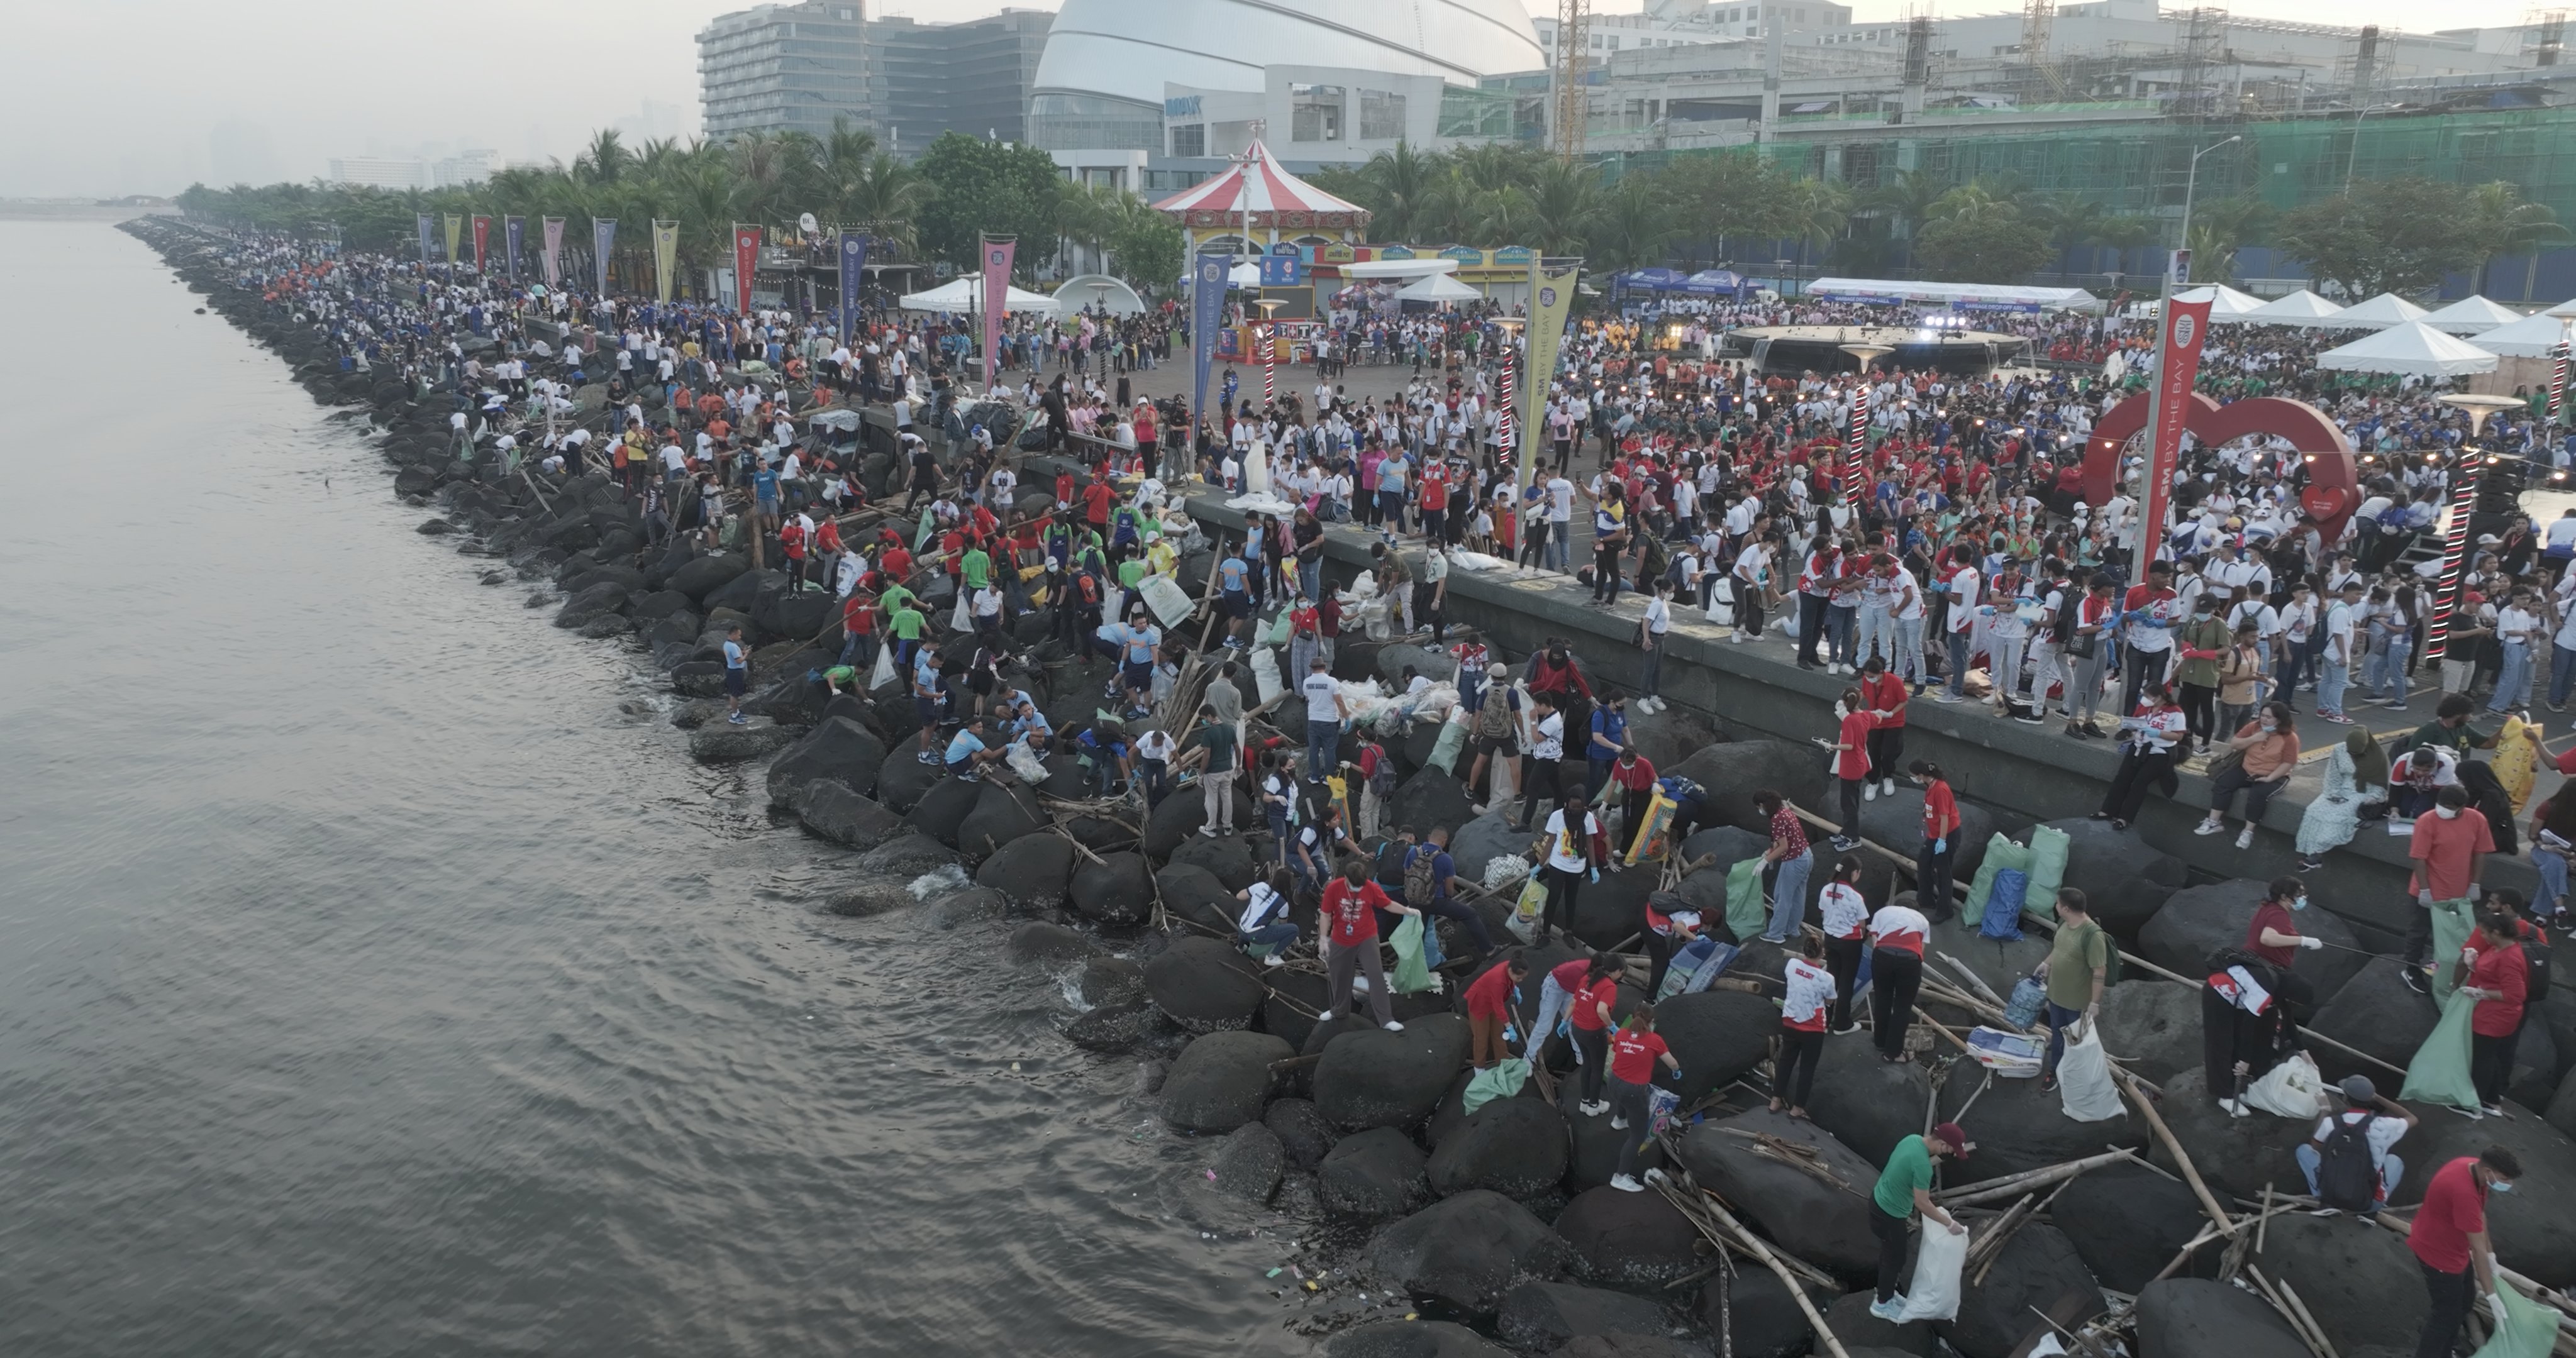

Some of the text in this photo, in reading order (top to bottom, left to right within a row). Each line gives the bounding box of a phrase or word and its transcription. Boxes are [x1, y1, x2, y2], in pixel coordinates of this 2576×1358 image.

[1165, 96, 1202, 116] IMAX
[849, 286, 855, 297] BY
[849, 297, 855, 309] SM
[996, 317, 1002, 331] SM
[1206, 329, 1214, 344] BY
[1206, 346, 1213, 363] SM
[1538, 314, 1550, 396] SM BY THE BAY
[2160, 359, 2184, 497] SM BY THE BAY
[2151, 720, 2166, 731] SAS
[1795, 968, 1815, 981] BIOLOGY
